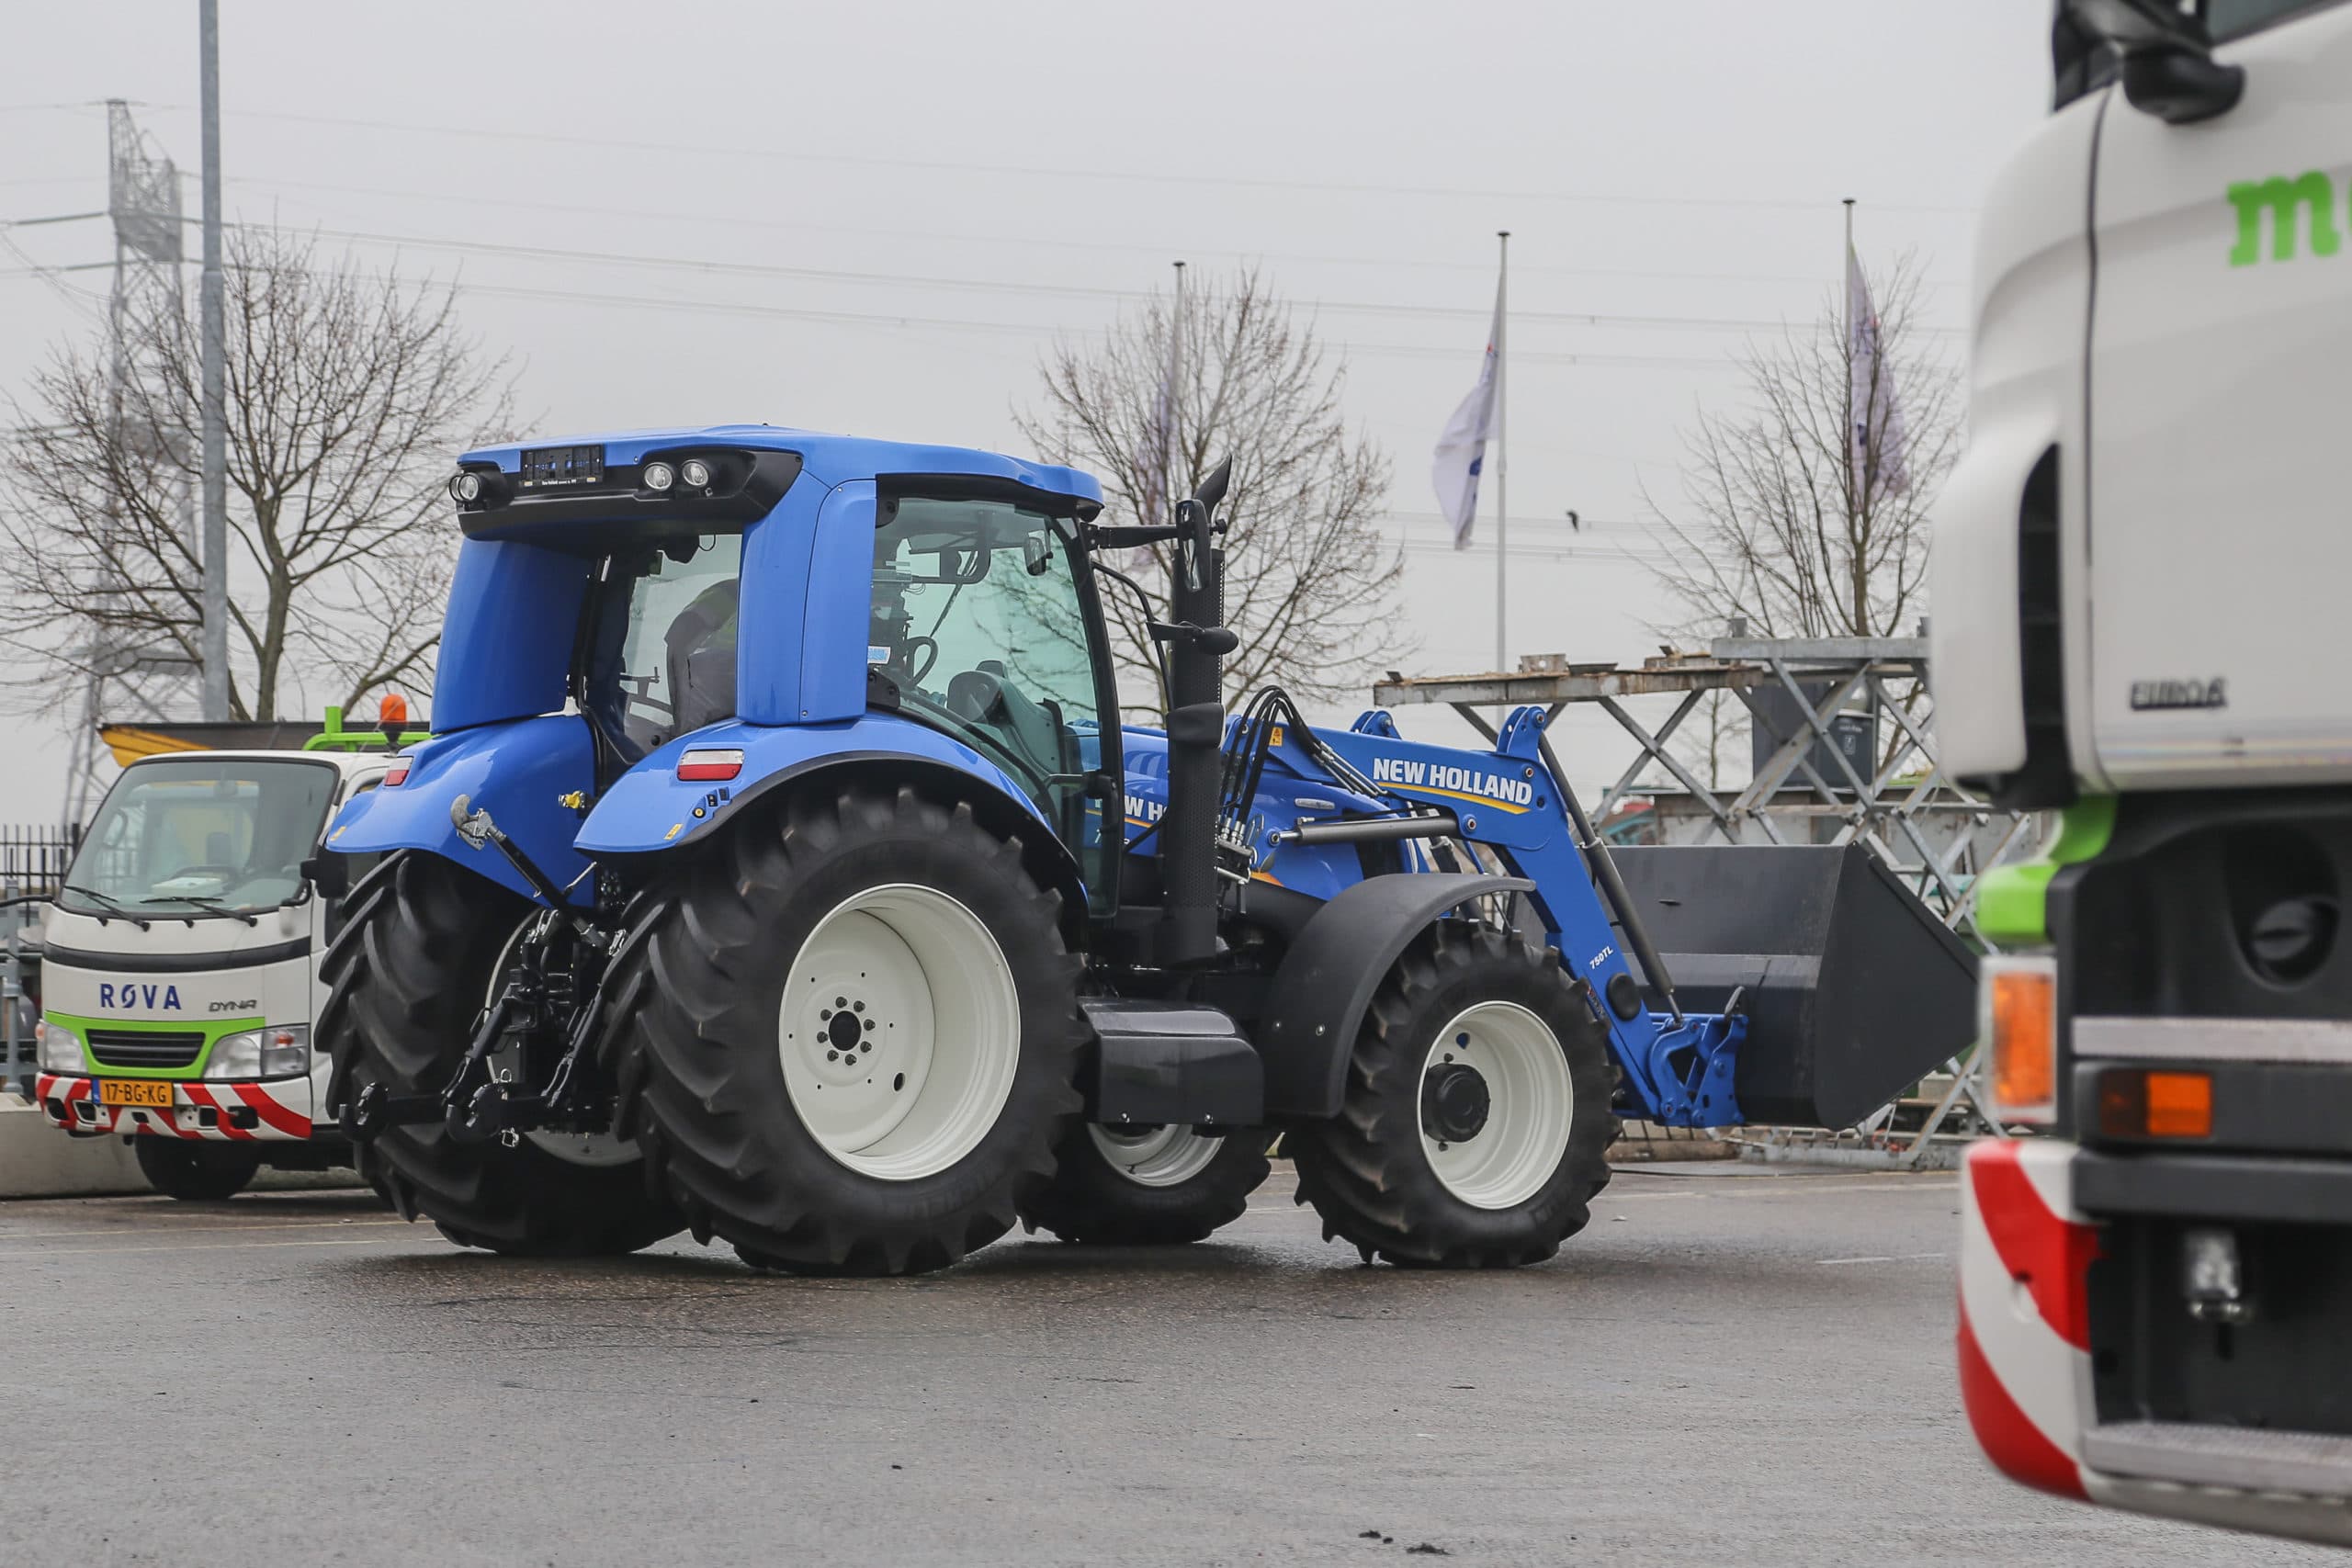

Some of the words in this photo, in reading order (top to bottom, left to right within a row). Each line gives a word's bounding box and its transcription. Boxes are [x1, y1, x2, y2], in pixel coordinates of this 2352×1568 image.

[1373, 758, 1426, 784] NEW
[1429, 763, 1532, 805] HOLLAND
[1589, 945, 1614, 970] 750TL
[208, 999, 258, 1012] DYNA
[104, 1083, 166, 1103] 17-BG-KG
